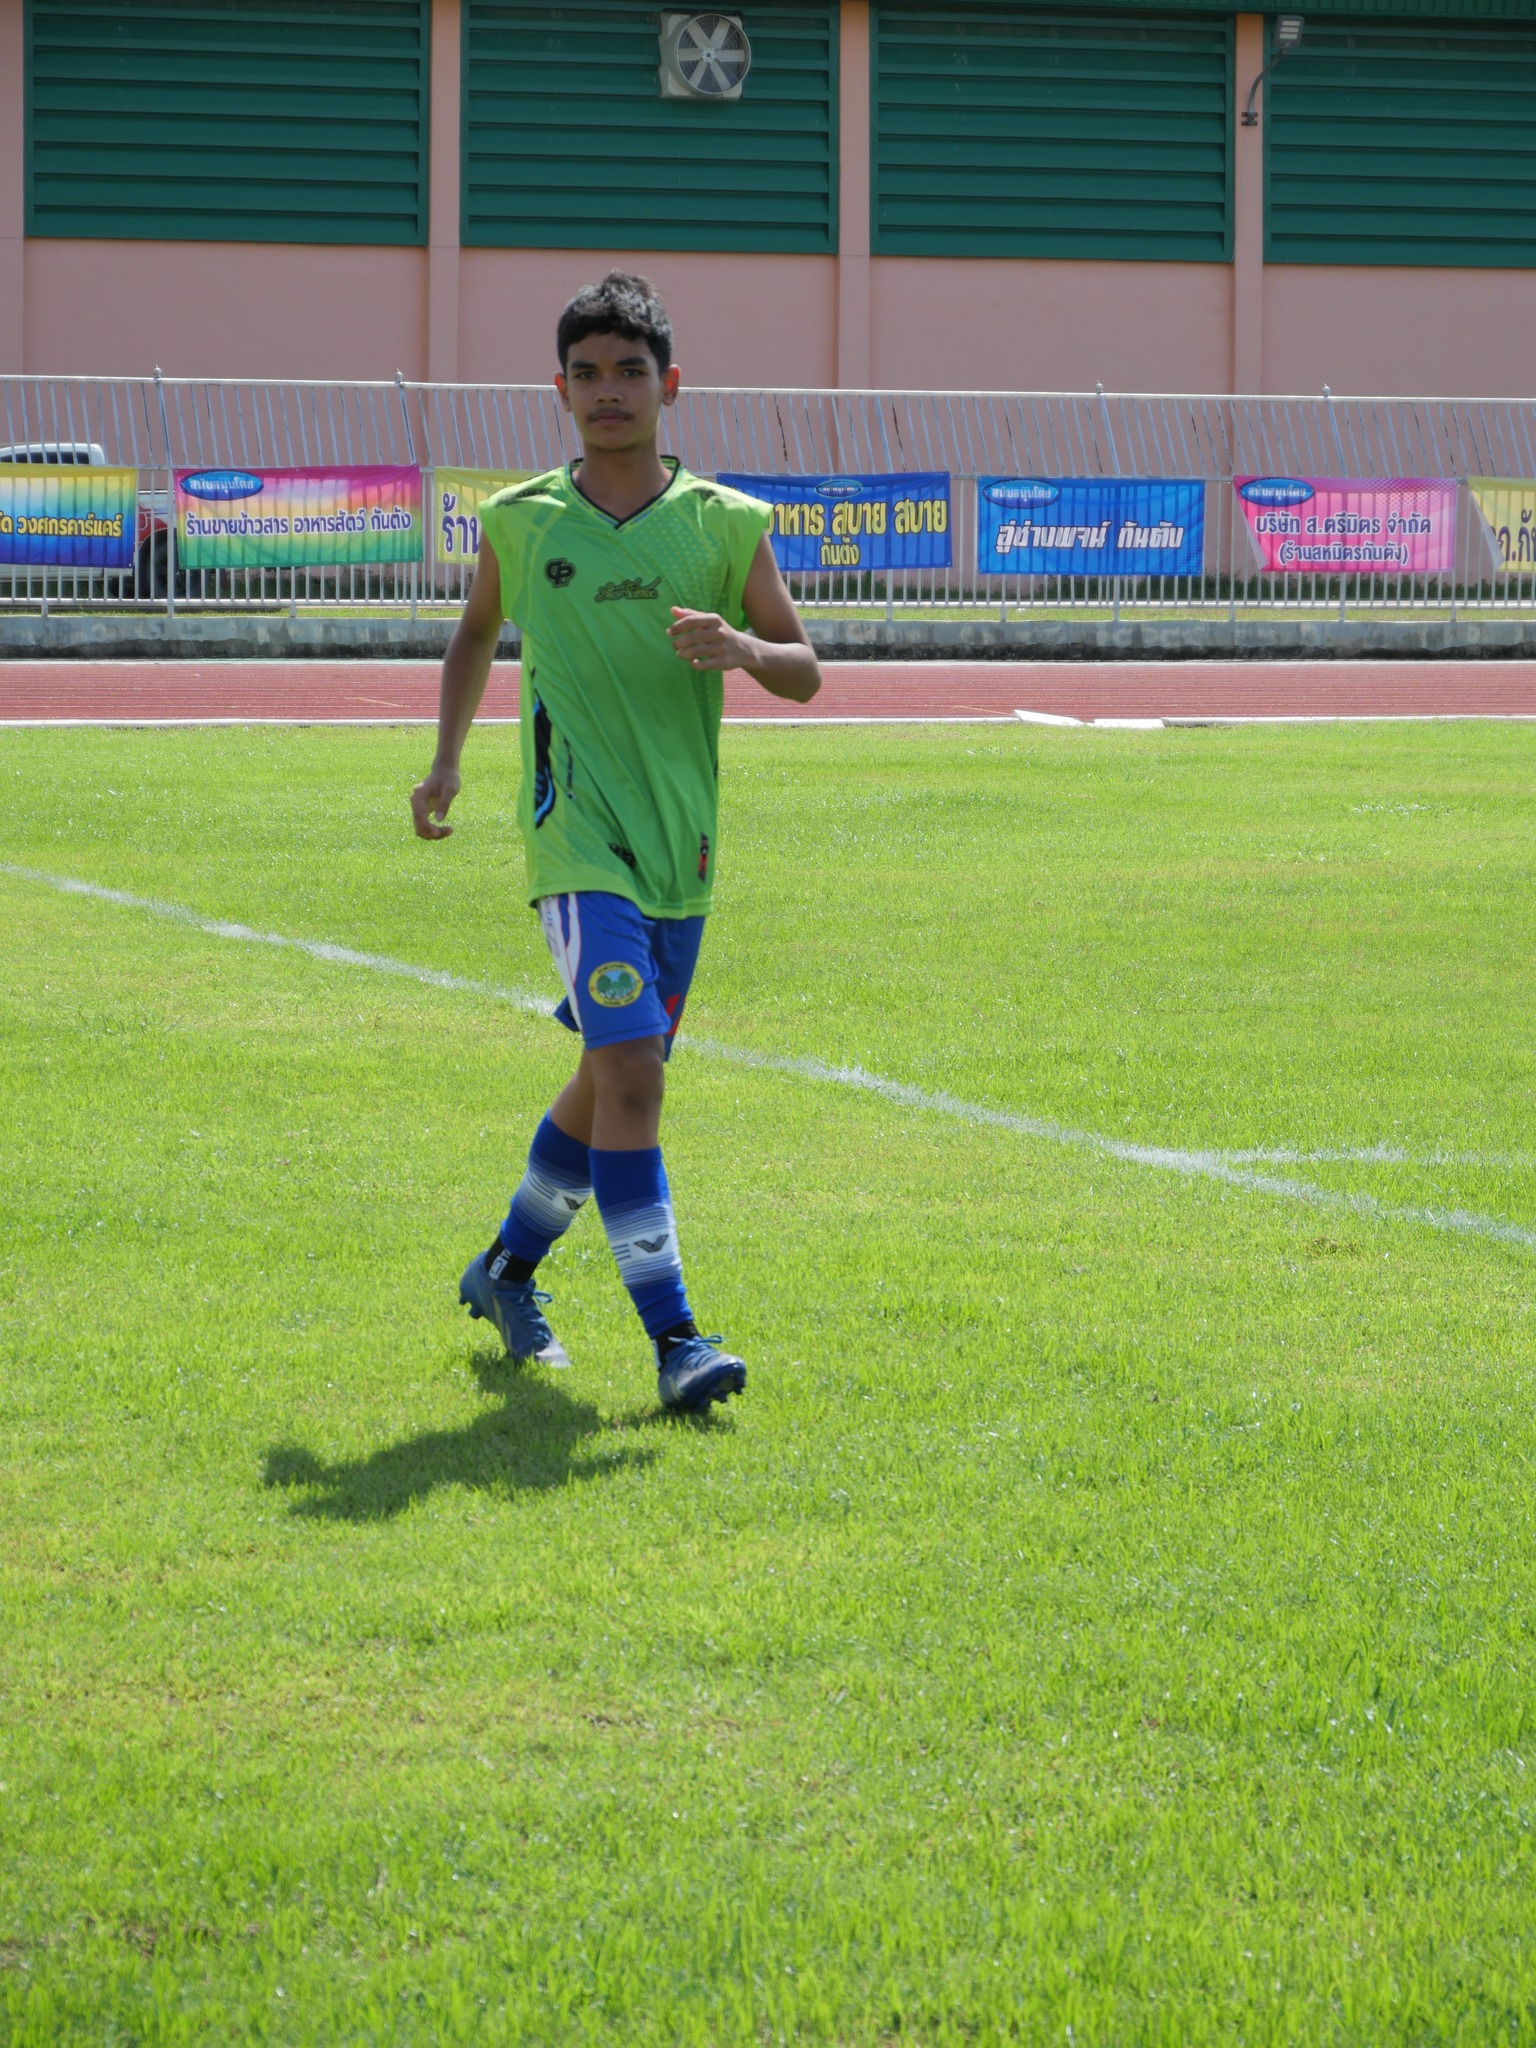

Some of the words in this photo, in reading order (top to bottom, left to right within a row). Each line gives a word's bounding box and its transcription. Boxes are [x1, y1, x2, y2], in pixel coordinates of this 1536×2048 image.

[186, 512, 289, 536] ร้านขายข้าวสาร
[294, 509, 366, 532] อาหารสัตว์
[832, 500, 887, 536] สบาย
[893, 497, 948, 535] สบาย
[1255, 512, 1301, 534] บริษัท
[1387, 511, 1432, 534] จำกัด
[1116, 520, 1184, 549] กันตัง
[820, 536, 861, 566] กันตัง
